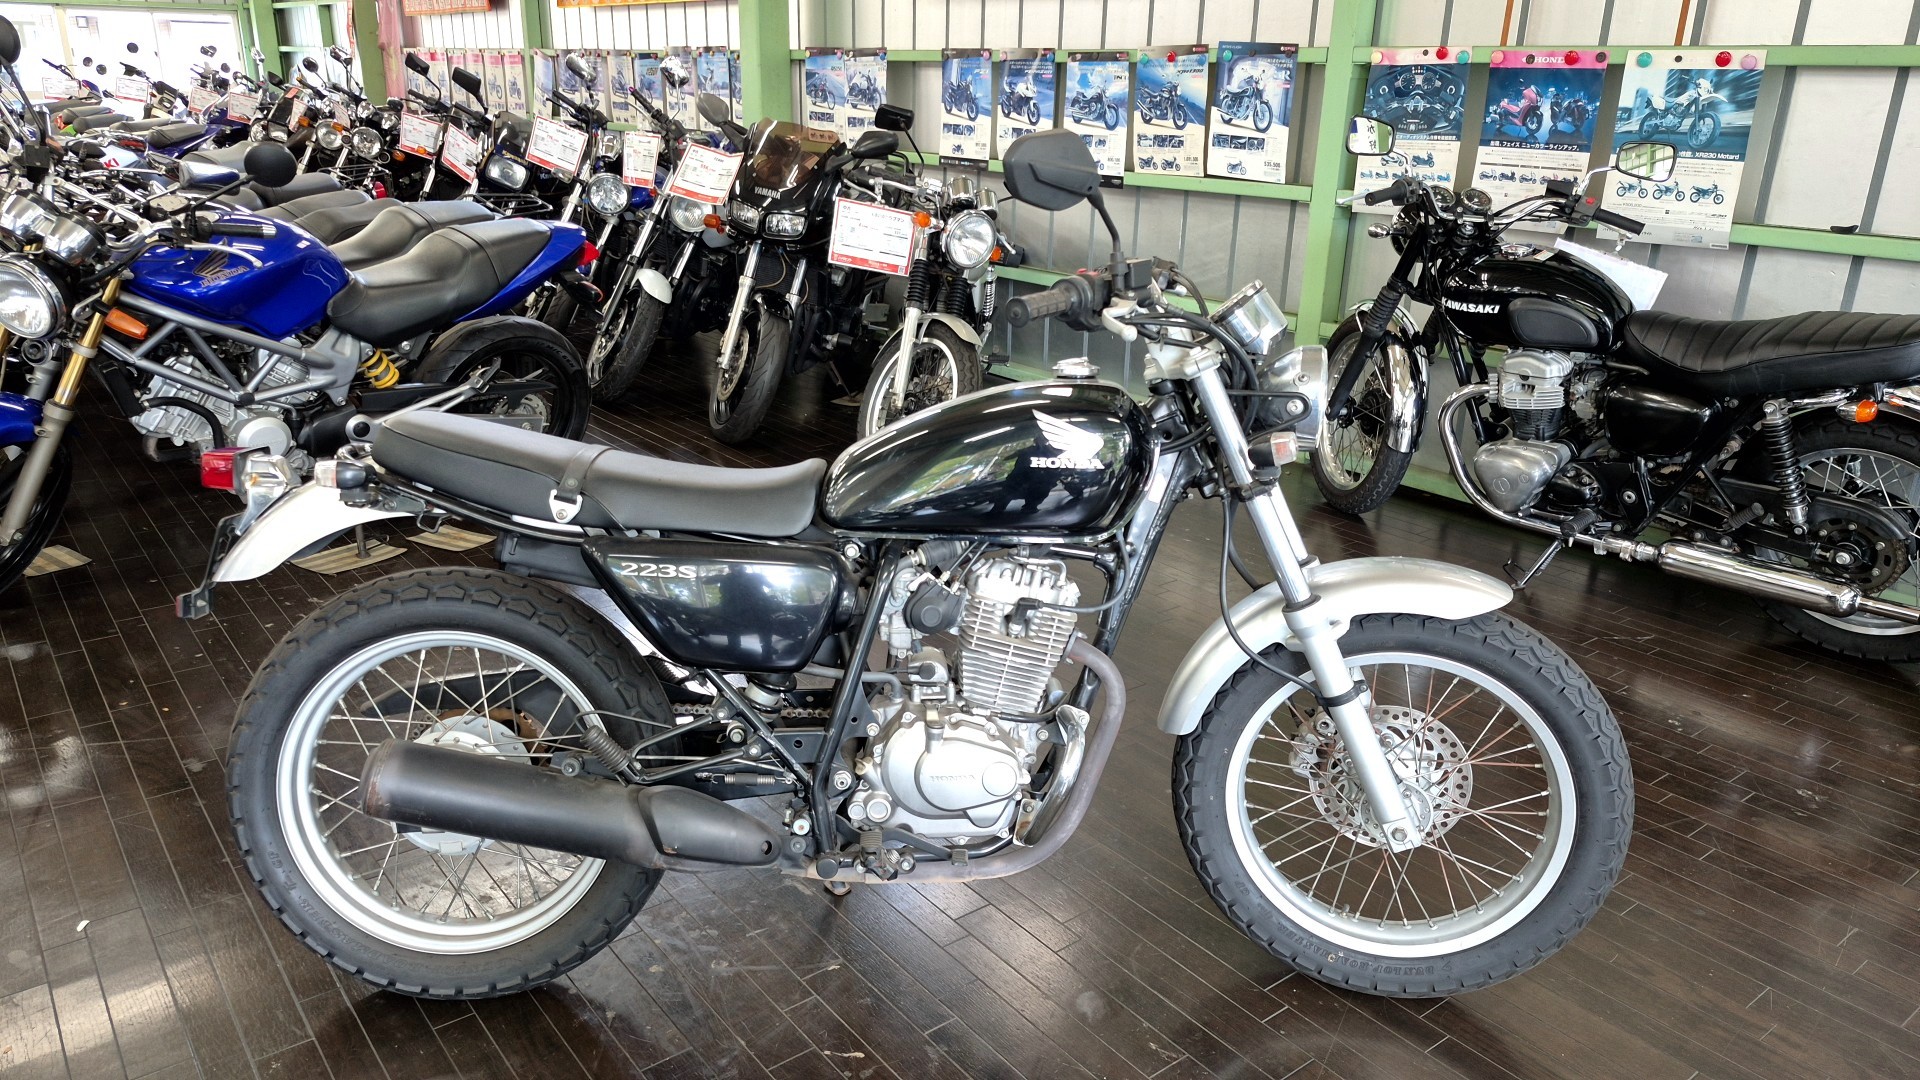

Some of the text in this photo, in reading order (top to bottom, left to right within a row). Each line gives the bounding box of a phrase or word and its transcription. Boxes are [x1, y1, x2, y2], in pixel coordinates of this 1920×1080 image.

[1535, 56, 1566, 64] HOND
[755, 186, 780, 200] YAMAHA
[1442, 297, 1500, 314] KAWASAKI
[1030, 456, 1105, 470] HONDA
[620, 562, 698, 579] 223S
